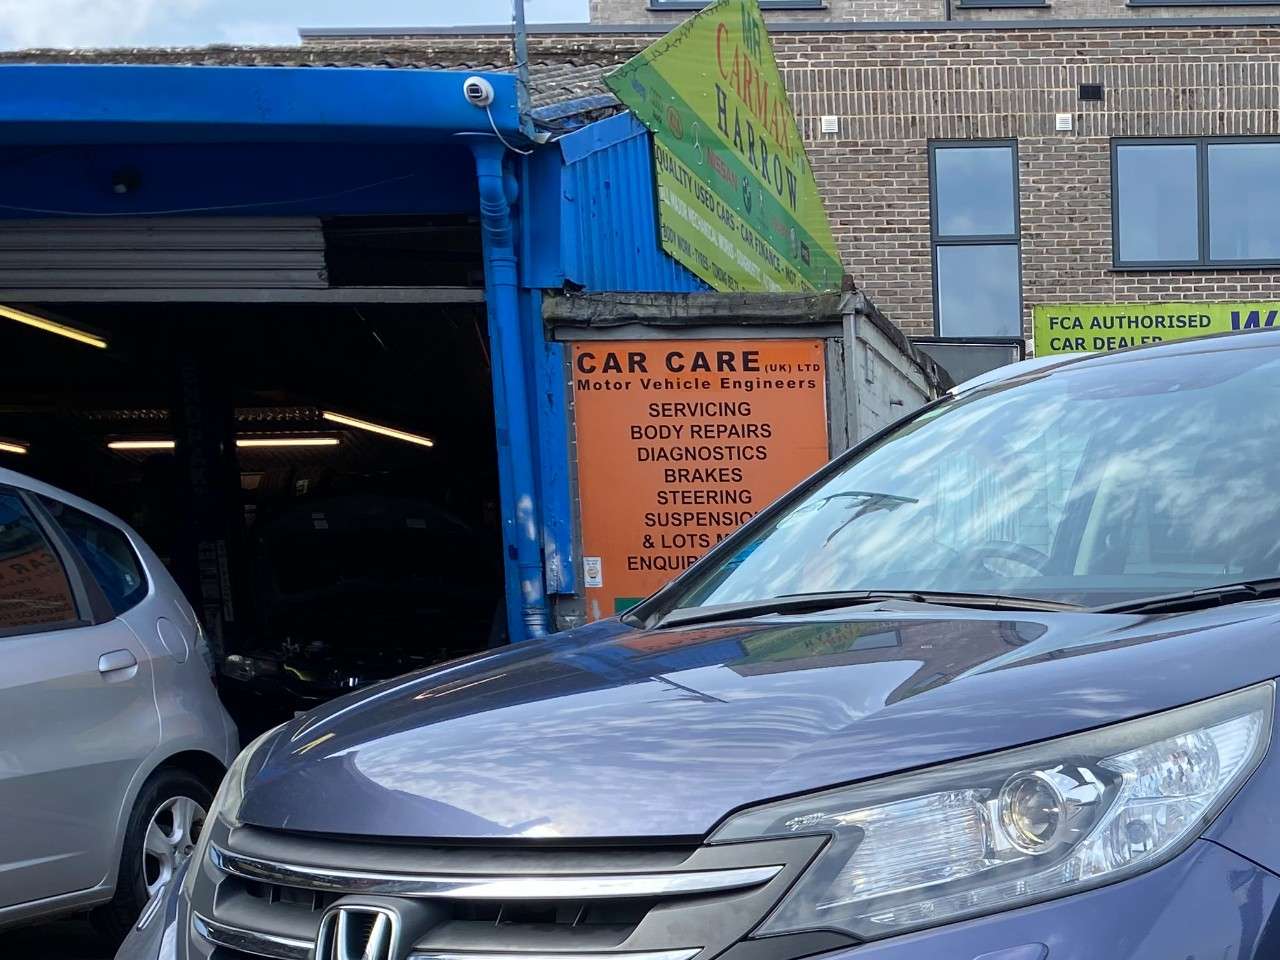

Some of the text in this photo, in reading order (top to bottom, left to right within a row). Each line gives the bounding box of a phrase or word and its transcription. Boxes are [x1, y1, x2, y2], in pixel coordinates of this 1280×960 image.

[715, 82, 797, 213] HARROW
[655, 144, 692, 193] QUALITY
[694, 180, 715, 212] USED
[717, 201, 736, 231] CARS
[1049, 314, 1212, 330] FCA AUTHORISED
[1049, 337, 1087, 351] CAR
[576, 350, 821, 374] CAR CARE (UK) LTD
[577, 377, 816, 393] Motor Vehicle Engineers
[648, 402, 752, 417] SERVICING
[630, 423, 772, 440] BODY REPAIRS
[637, 446, 767, 462] DIAGNOSTICS
[664, 468, 743, 483] BRAKES
[657, 490, 752, 505] STEERING
[644, 511, 757, 527] SUSPENSIO
[642, 534, 655, 549] &
[661, 533, 711, 549] LOTS
[627, 555, 702, 571] ENQUIR
